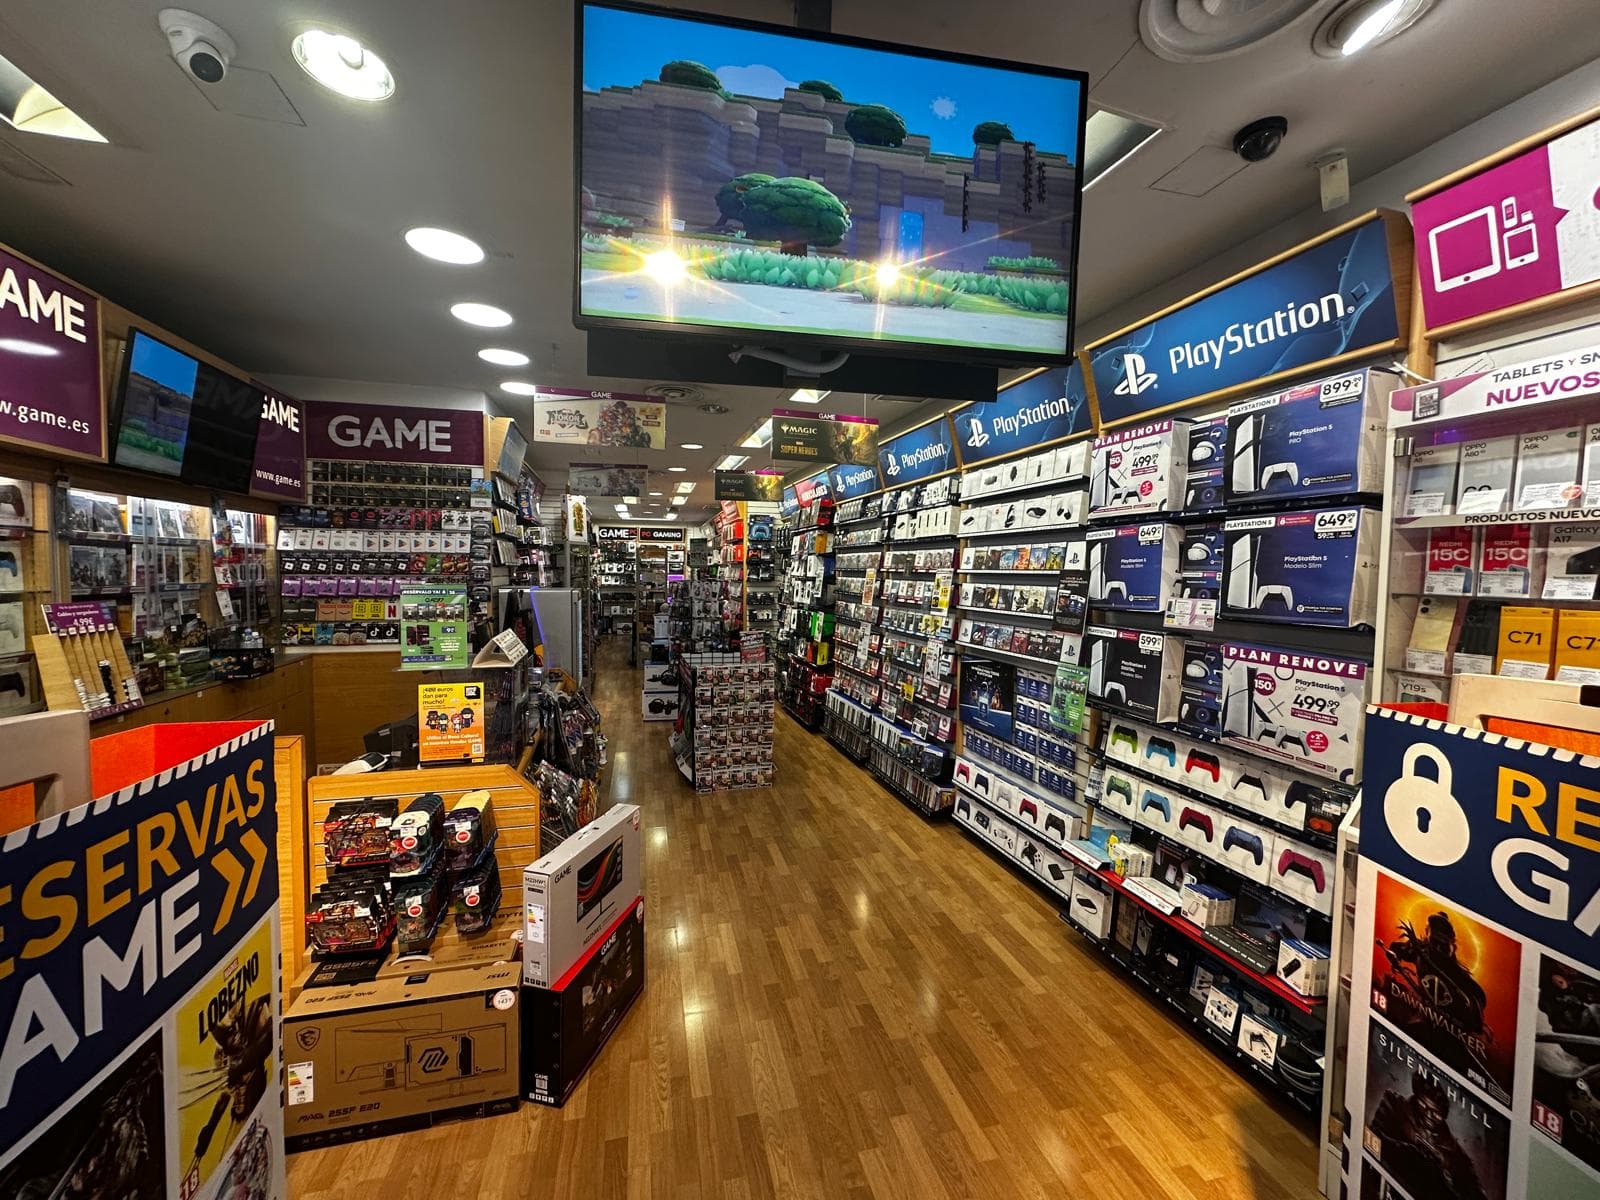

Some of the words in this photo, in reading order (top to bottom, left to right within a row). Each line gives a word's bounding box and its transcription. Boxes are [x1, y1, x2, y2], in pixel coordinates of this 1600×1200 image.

[1169, 293, 1347, 376] PlayStation
[1492, 359, 1564, 383] TABLETS
[591, 391, 612, 399] GAME
[1486, 371, 1600, 407] NUEVOS
[1229, 400, 1269, 415] PLAYSTATION
[818, 413, 836, 421] GAME
[993, 397, 1074, 436] PlayStation
[327, 415, 452, 453] GAME
[789, 426, 818, 434] MAGIC
[1094, 433, 1120, 448] PLAN
[1124, 421, 1169, 438] RENOVE
[1289, 426, 1327, 437] PlayStation
[1465, 442, 1487, 451] OPPO
[1523, 434, 1549, 444] OPPO
[901, 442, 947, 469] PlayStation
[1414, 449, 1434, 458] OPPO
[256, 468, 301, 488] www.game.es
[845, 468, 874, 489] PlayStation
[1226, 520, 1265, 529] PLAYSTATION
[1464, 511, 1546, 525] PRODUCTOS
[600, 529, 629, 539] GAME
[653, 531, 682, 539] GAMING
[1554, 525, 1600, 536] Galaxy
[1553, 535, 1572, 543] A17
[1284, 555, 1322, 563] PlayStation
[1432, 548, 1471, 562] 15C
[1486, 547, 1528, 562] 15C
[1507, 631, 1542, 646] C71
[1229, 647, 1271, 662] PLAN
[1279, 654, 1358, 676] RENOVE
[1295, 678, 1340, 691] PlayStation
[1401, 682, 1426, 692] Y19s
[555, 865, 572, 884] GAME
[471, 942, 507, 950] GIGABYTE
[601, 931, 617, 956] GAME
[198, 952, 260, 1045] LOBEZNO
[1373, 990, 1387, 1010] 18
[1391, 982, 1488, 1060] DAWNWALKER
[1378, 1033, 1440, 1088] SILENT
[1446, 1087, 1493, 1130] HILL
[297, 1112, 325, 1124] MAG
[328, 1106, 356, 1119] 255F
[359, 1102, 382, 1113] E20
[1534, 1104, 1561, 1134] 18
[183, 1167, 199, 1200] 18
